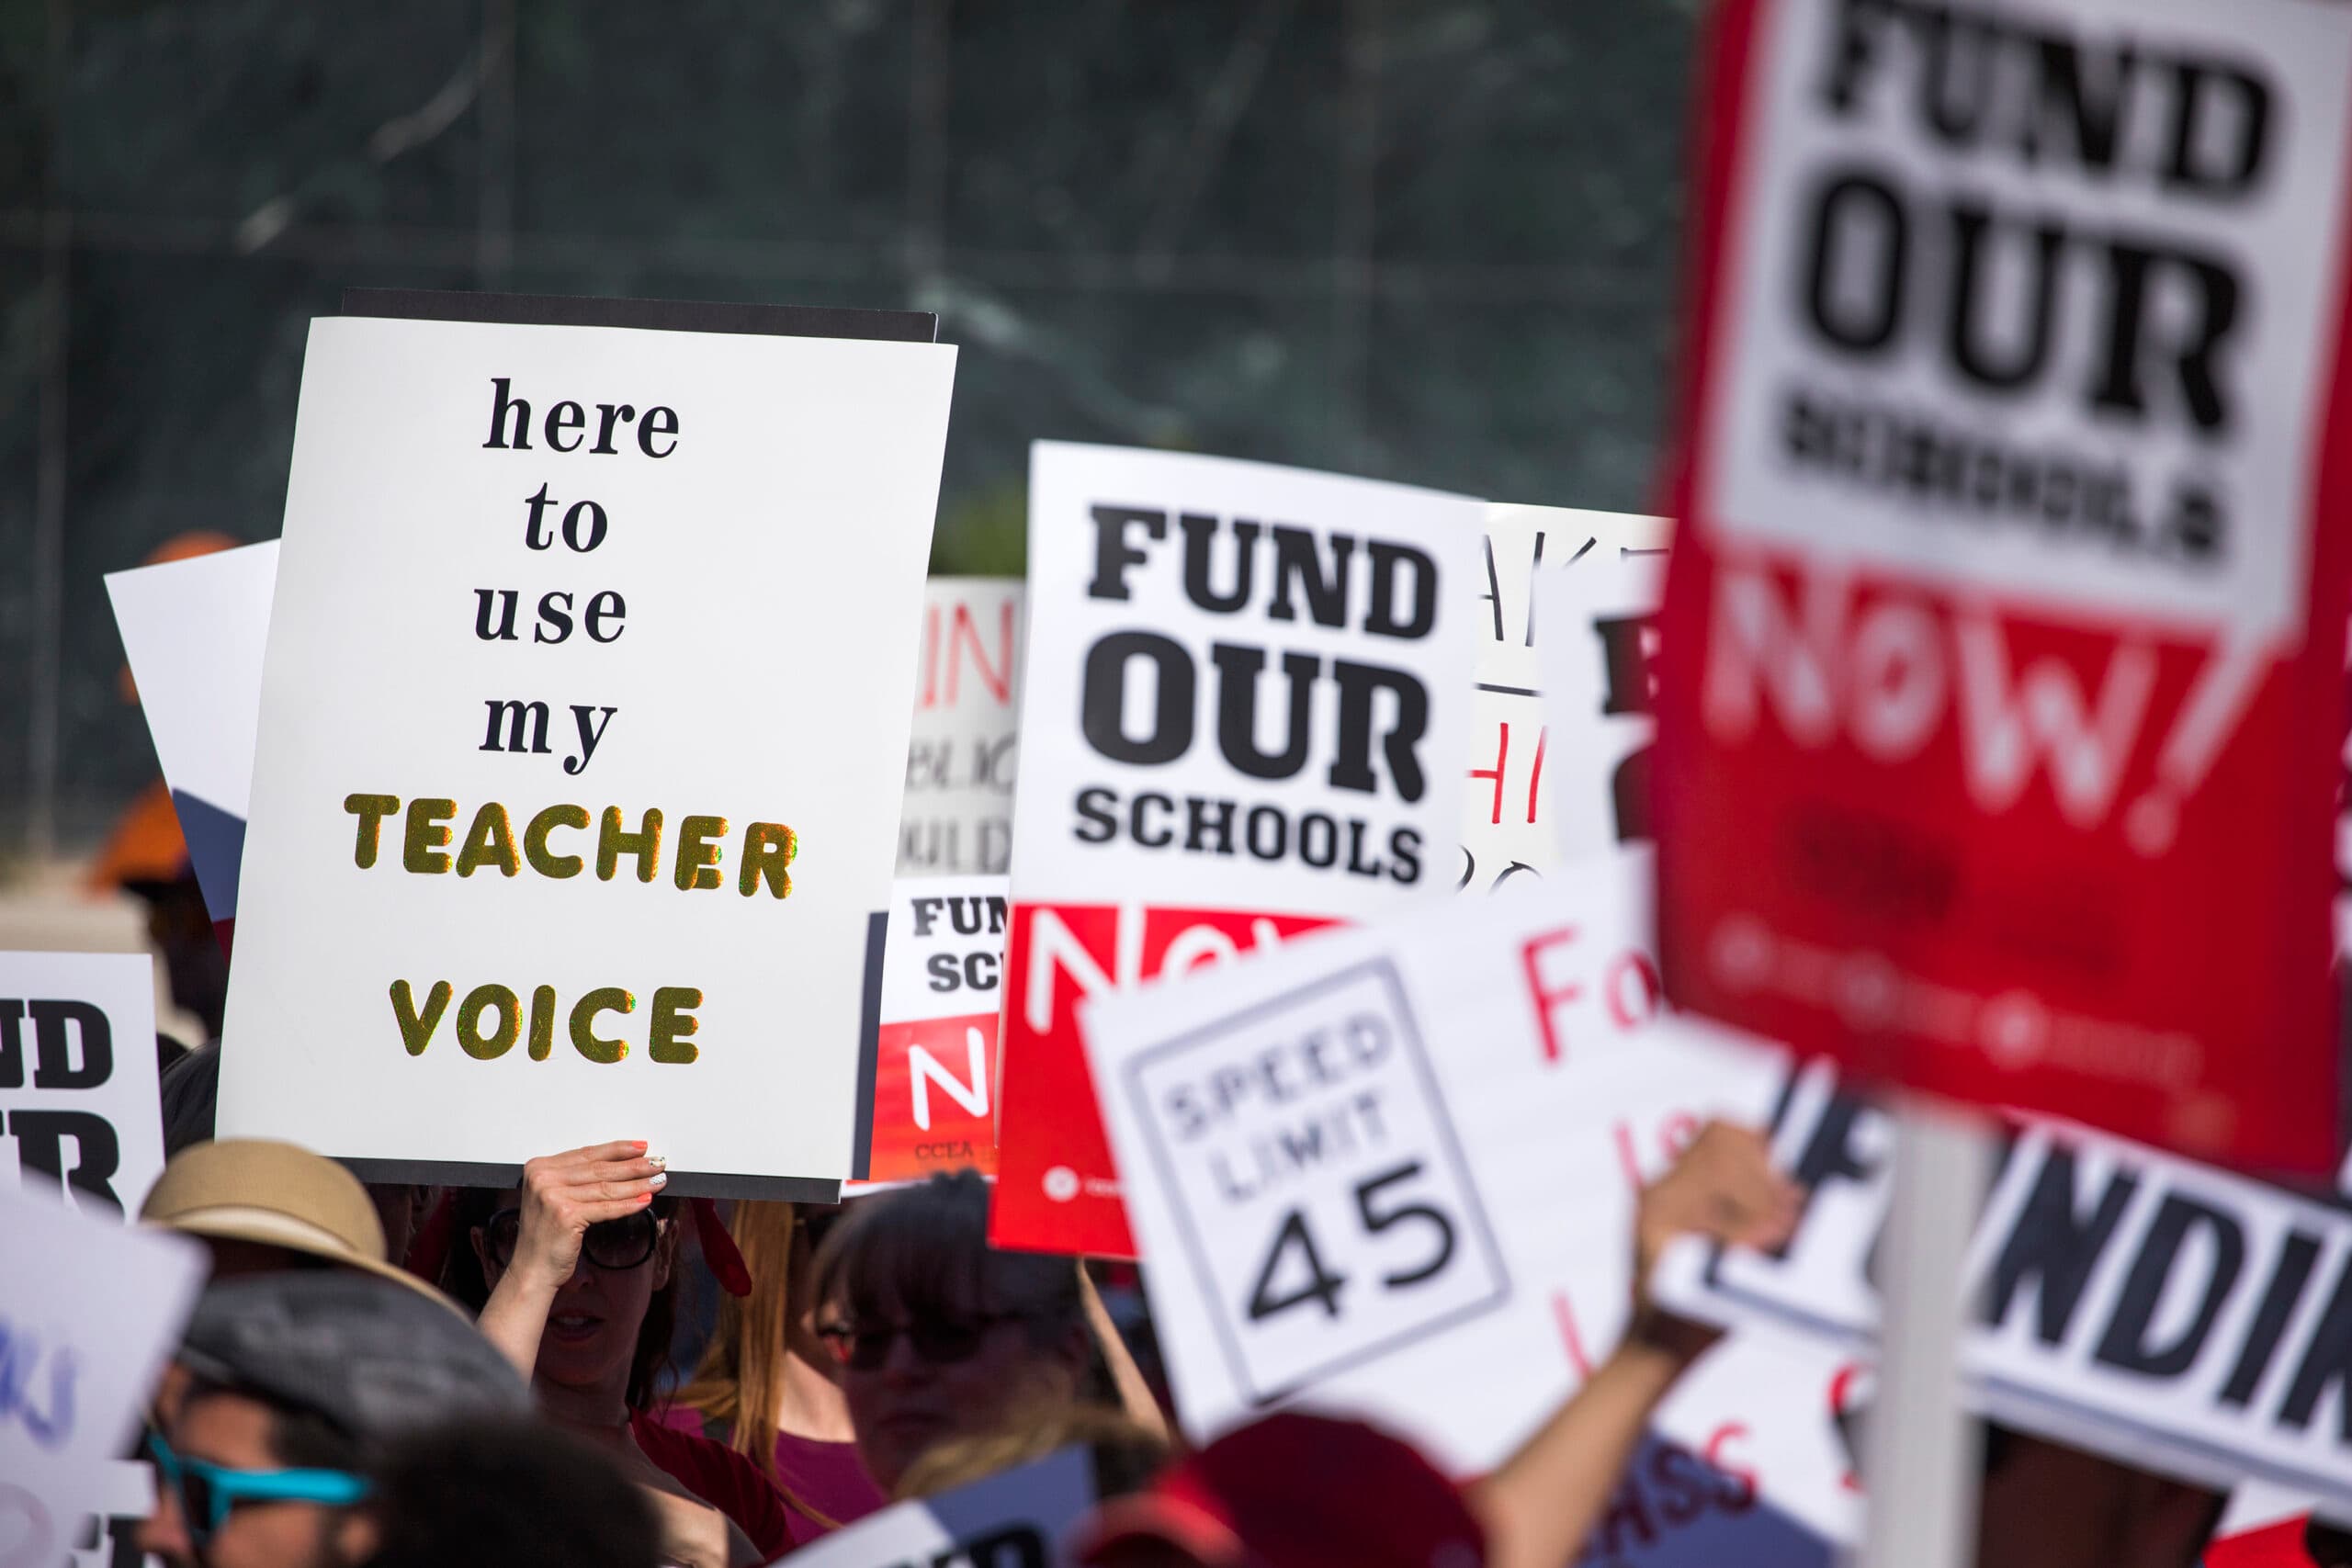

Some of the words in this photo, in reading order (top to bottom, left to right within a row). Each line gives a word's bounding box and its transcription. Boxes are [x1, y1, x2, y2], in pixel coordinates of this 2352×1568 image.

[1824, 0, 2277, 198] FUND
[1803, 173, 2249, 439] OUR
[482, 378, 679, 458] here
[525, 482, 608, 552] to
[1778, 390, 2227, 564] SCHOOLS
[473, 588, 627, 644] use
[1088, 505, 1440, 639] FUND
[478, 700, 618, 776] my
[1081, 631, 1430, 803] OUR
[344, 793, 798, 899] TEACHER
[1075, 788, 1423, 885] SCHOOLS
[390, 979, 703, 1064] VOICE
[1165, 1012, 1393, 1139] SPEED
[1210, 1088, 1385, 1200] LIMIT
[1248, 1159, 1457, 1323] 45
